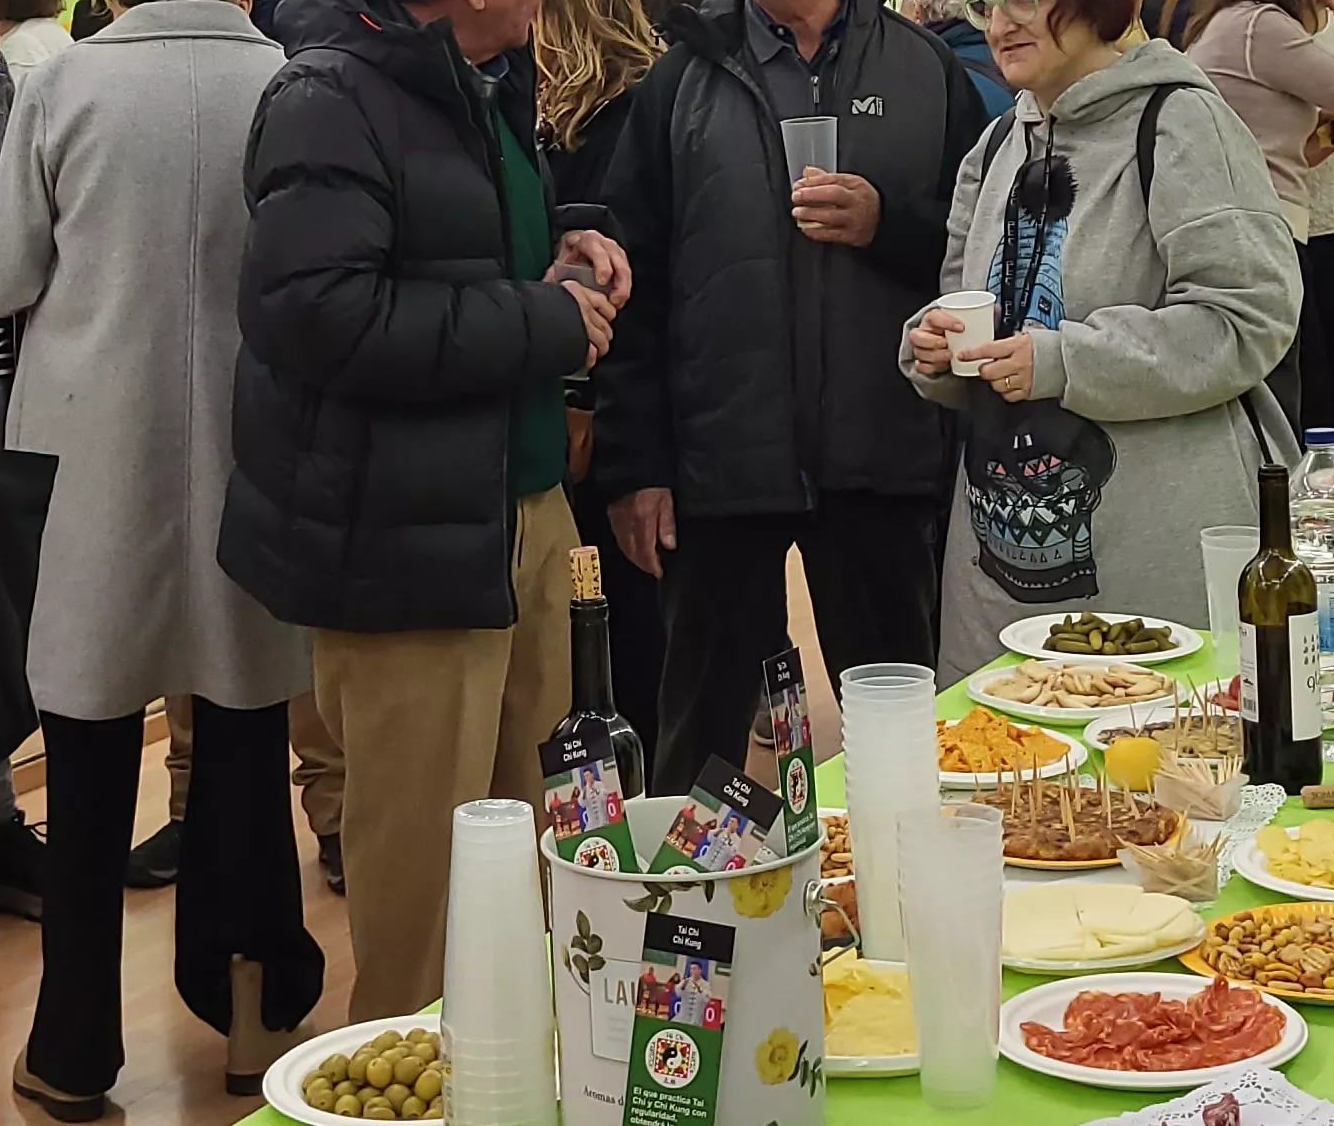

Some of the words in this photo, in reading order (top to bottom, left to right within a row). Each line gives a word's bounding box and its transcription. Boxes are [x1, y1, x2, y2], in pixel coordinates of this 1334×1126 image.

[572, 738, 582, 749] Chi
[563, 752, 573, 762] Chi
[572, 749, 587, 759] Kung
[723, 785, 735, 796] Chi
[733, 790, 749, 807] Kung
[740, 783, 752, 795] Chi
[678, 925, 687, 935] Tai
[688, 927, 699, 937] Chi
[672, 935, 683, 945] Chi
[684, 937, 702, 950] Kung
[583, 1085, 616, 1105] Aromas
[633, 1086, 642, 1095] El
[643, 1090, 658, 1098] que
[659, 1093, 691, 1105] practica
[692, 1097, 705, 1107] Tai
[632, 1096, 646, 1105] Chi
[646, 1100, 653, 1108] y
[654, 1100, 667, 1110] Chi
[669, 1103, 690, 1116] Kung
[691, 1109, 707, 1118] con
